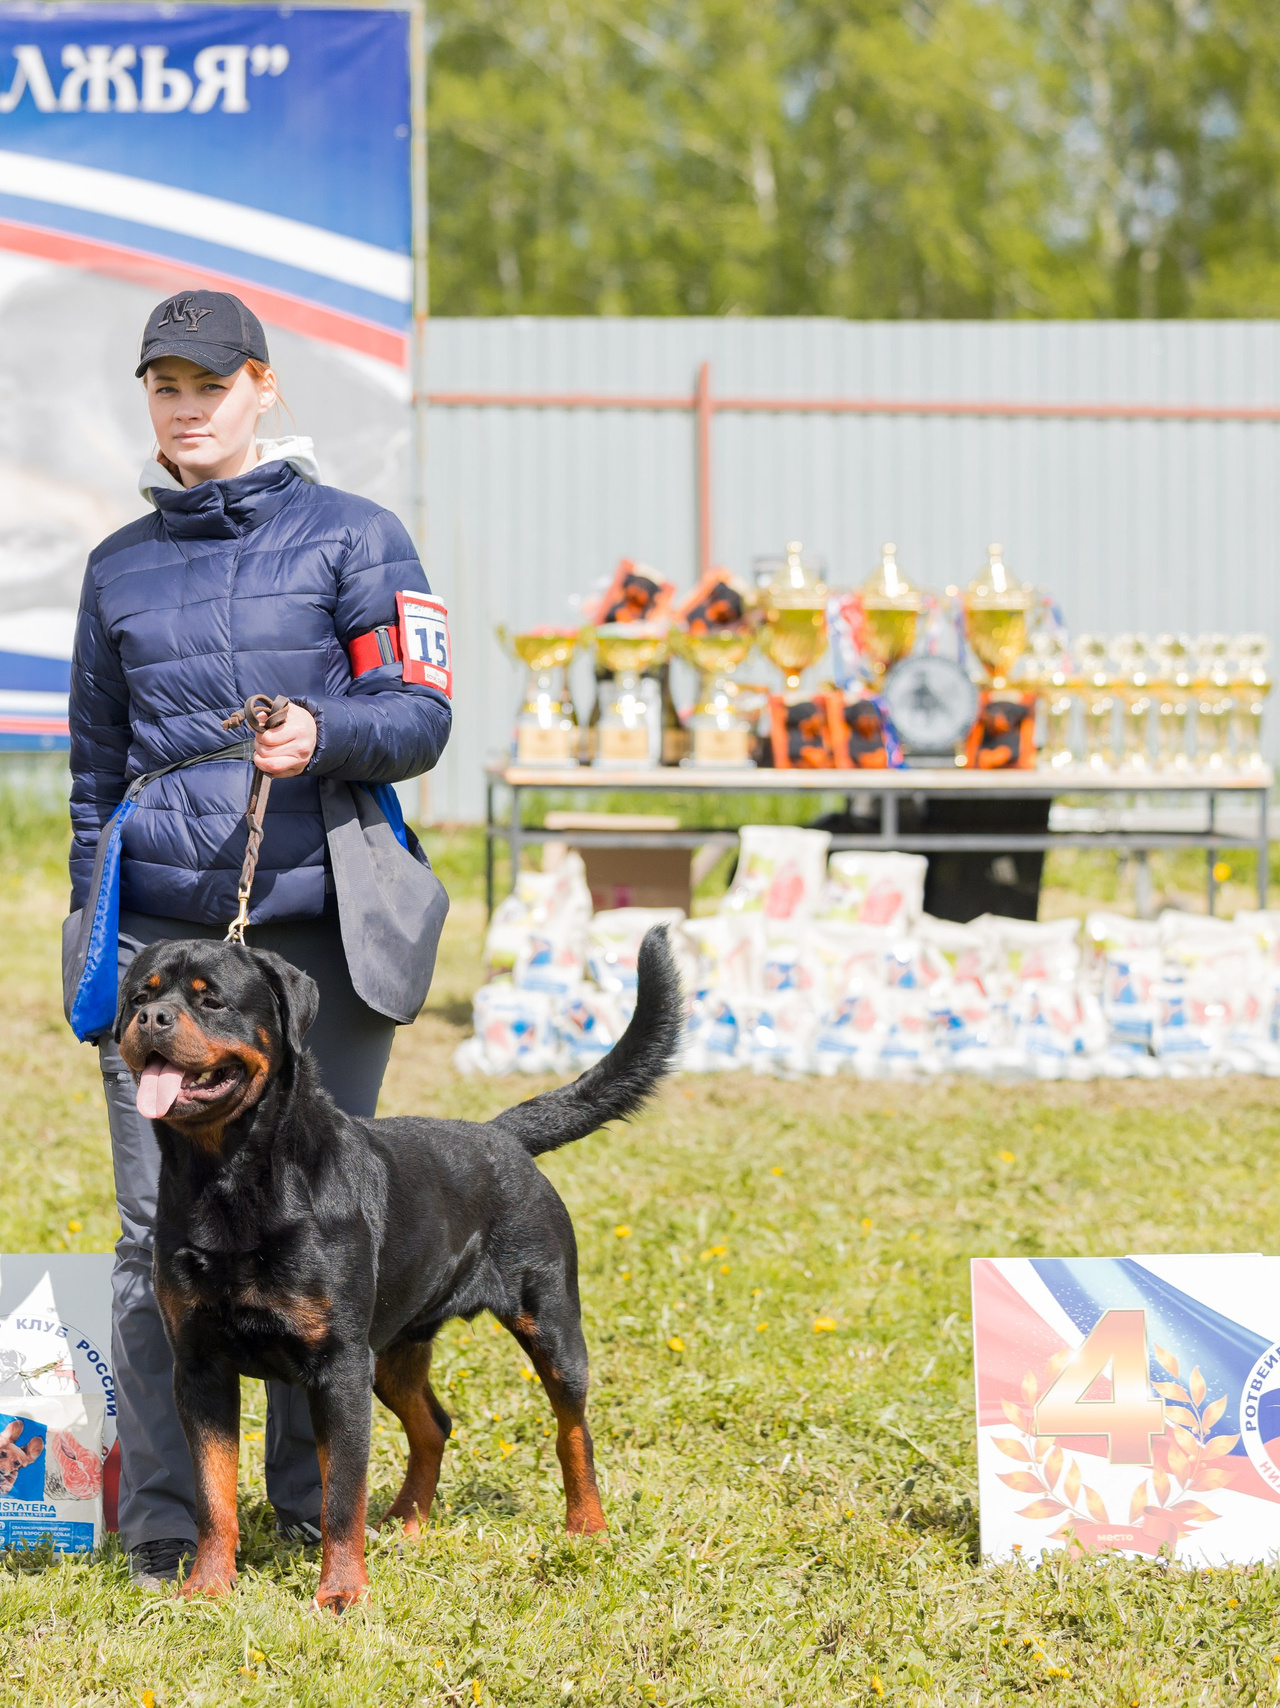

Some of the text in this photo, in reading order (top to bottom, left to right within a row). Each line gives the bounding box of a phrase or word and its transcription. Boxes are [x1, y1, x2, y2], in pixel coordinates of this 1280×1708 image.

[158, 296, 213, 332] NY
[414, 627, 447, 668] 15
[16, 1318, 69, 1339] КЛУБ
[76, 1339, 117, 1417] РОССИИ
[1034, 1308, 1167, 1467] 4
[1245, 1347, 1280, 1432] РОТВЕЙ
